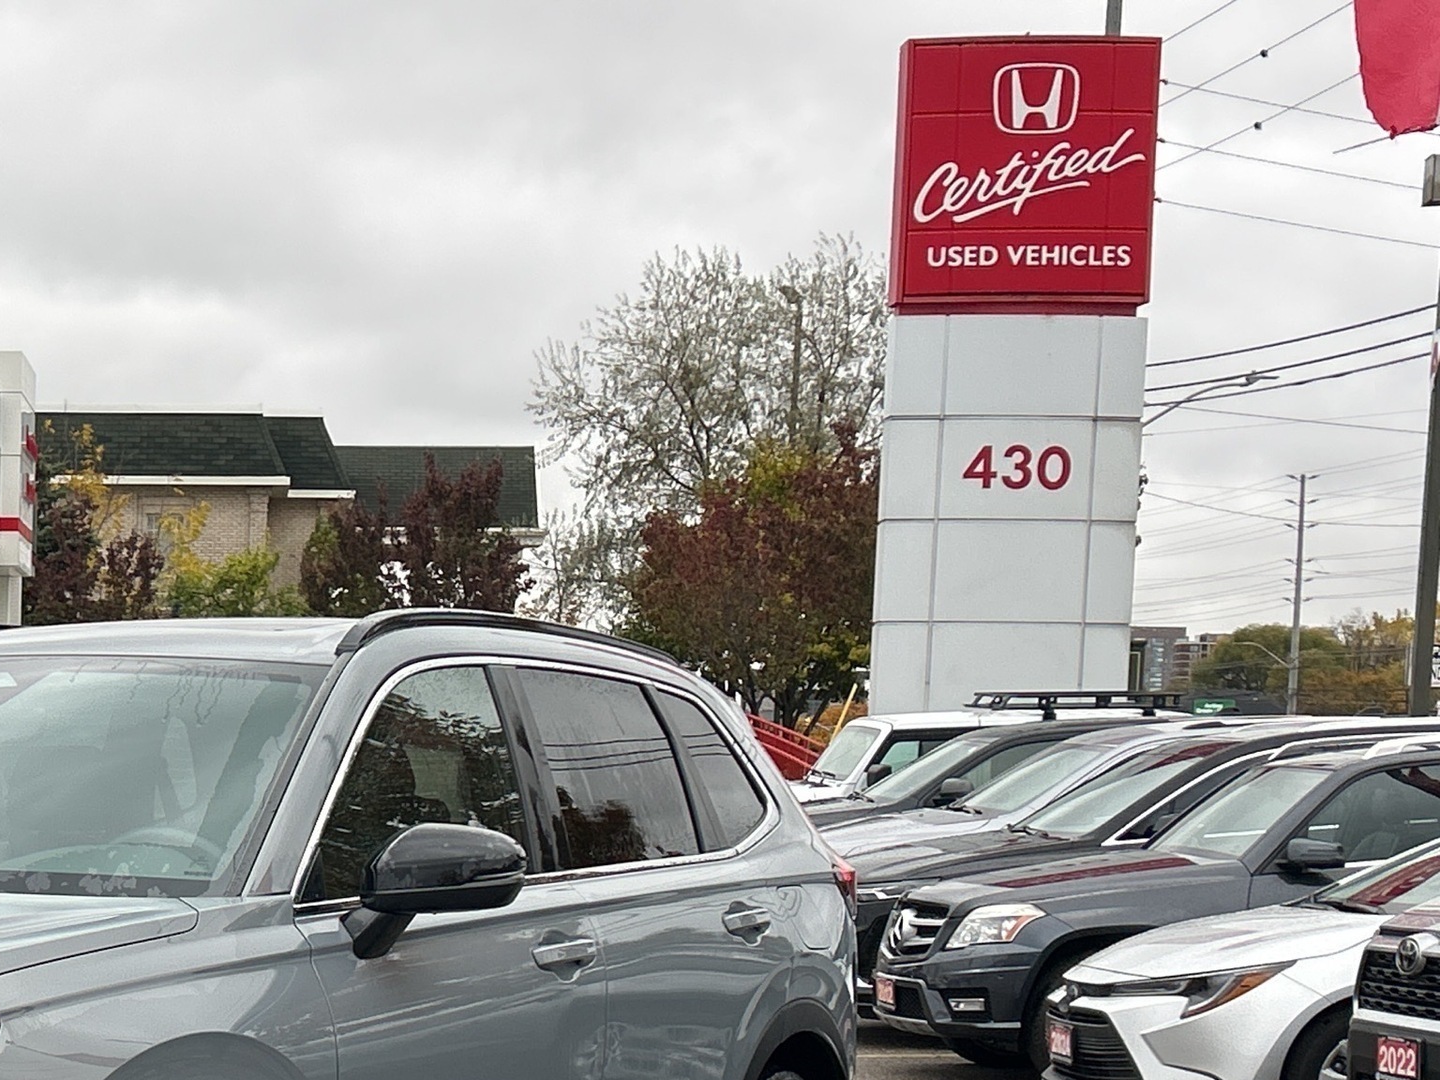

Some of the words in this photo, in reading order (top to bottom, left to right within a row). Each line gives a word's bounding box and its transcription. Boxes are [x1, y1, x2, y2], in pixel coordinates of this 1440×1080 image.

[913, 128, 1147, 223] Certified
[927, 245, 998, 268] USED
[1006, 245, 1131, 267] VEHICLES
[962, 446, 1072, 490] 430
[1378, 1044, 1417, 1078] 2022
